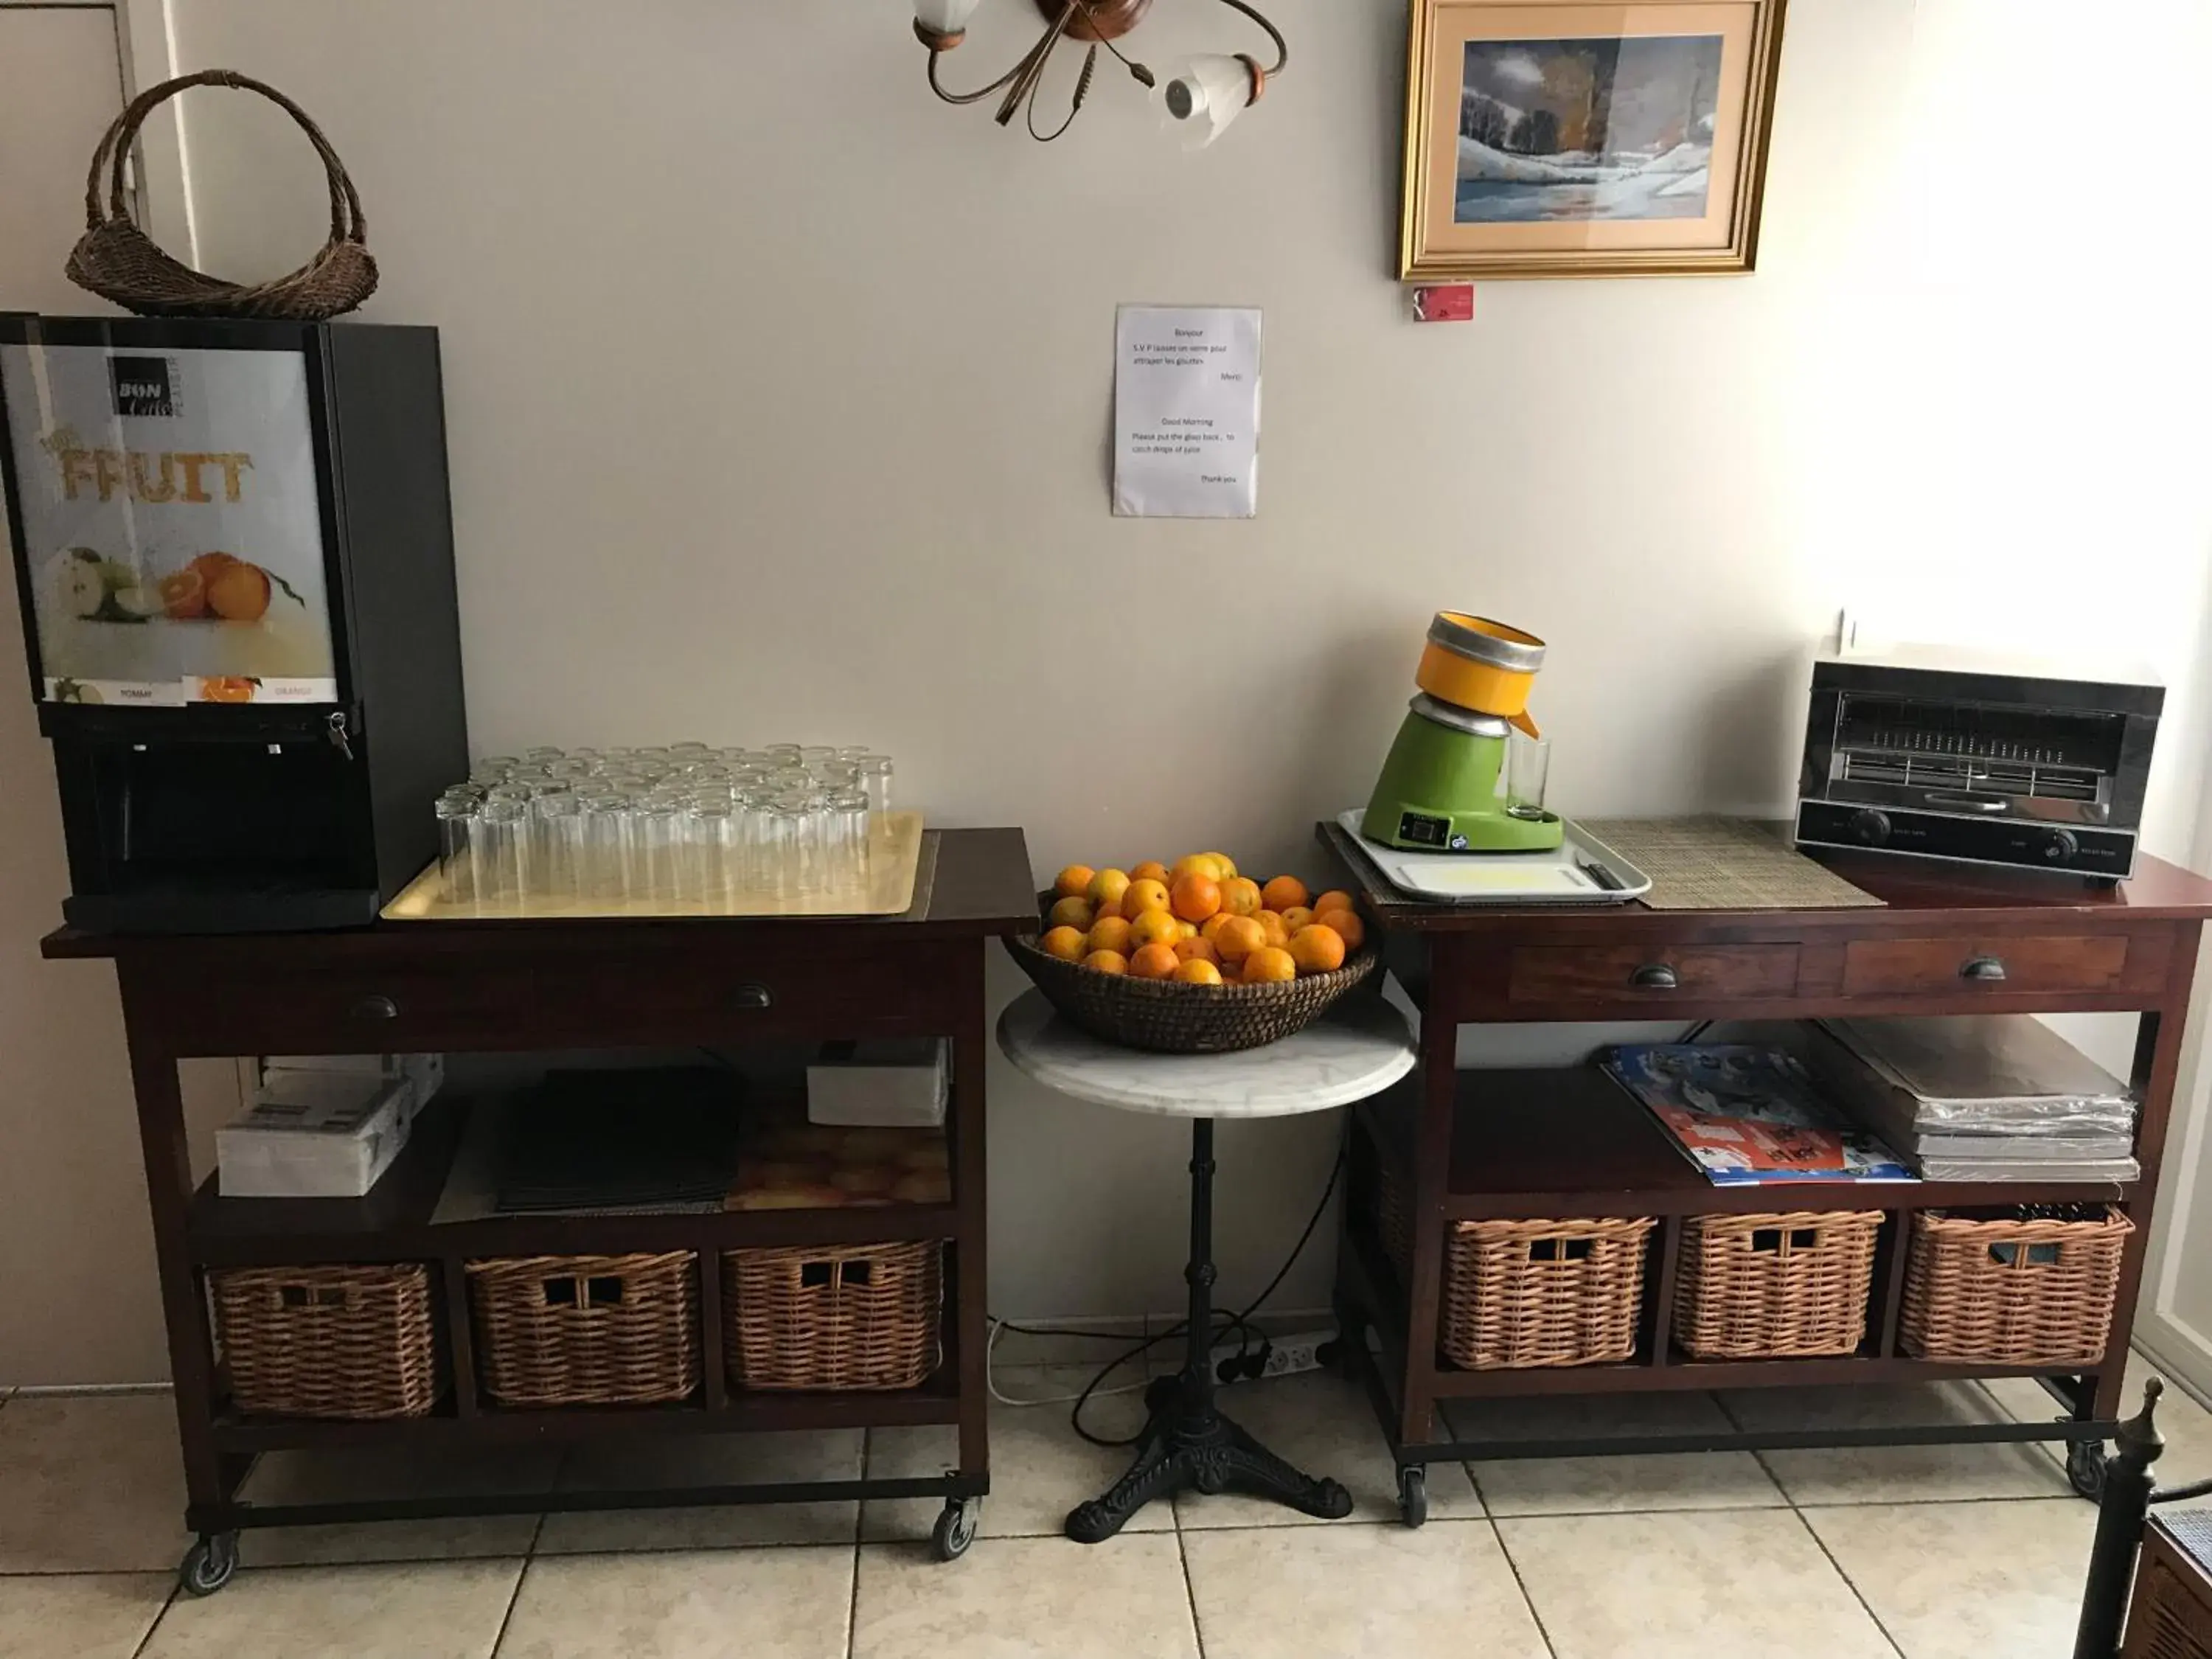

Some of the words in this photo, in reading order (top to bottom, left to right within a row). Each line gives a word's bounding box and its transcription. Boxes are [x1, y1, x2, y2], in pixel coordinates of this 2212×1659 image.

[1175, 328, 1203, 338] Bonjour
[1220, 372, 1242, 381] Merci
[1161, 417, 1181, 425] Good
[1183, 418, 1214, 427] Morning
[1132, 432, 1155, 440] Please
[1157, 433, 1169, 442] put
[1132, 445, 1152, 453] catch
[1153, 445, 1173, 454] drops
[60, 448, 252, 504] FRUIT
[1200, 474, 1222, 484] Thank
